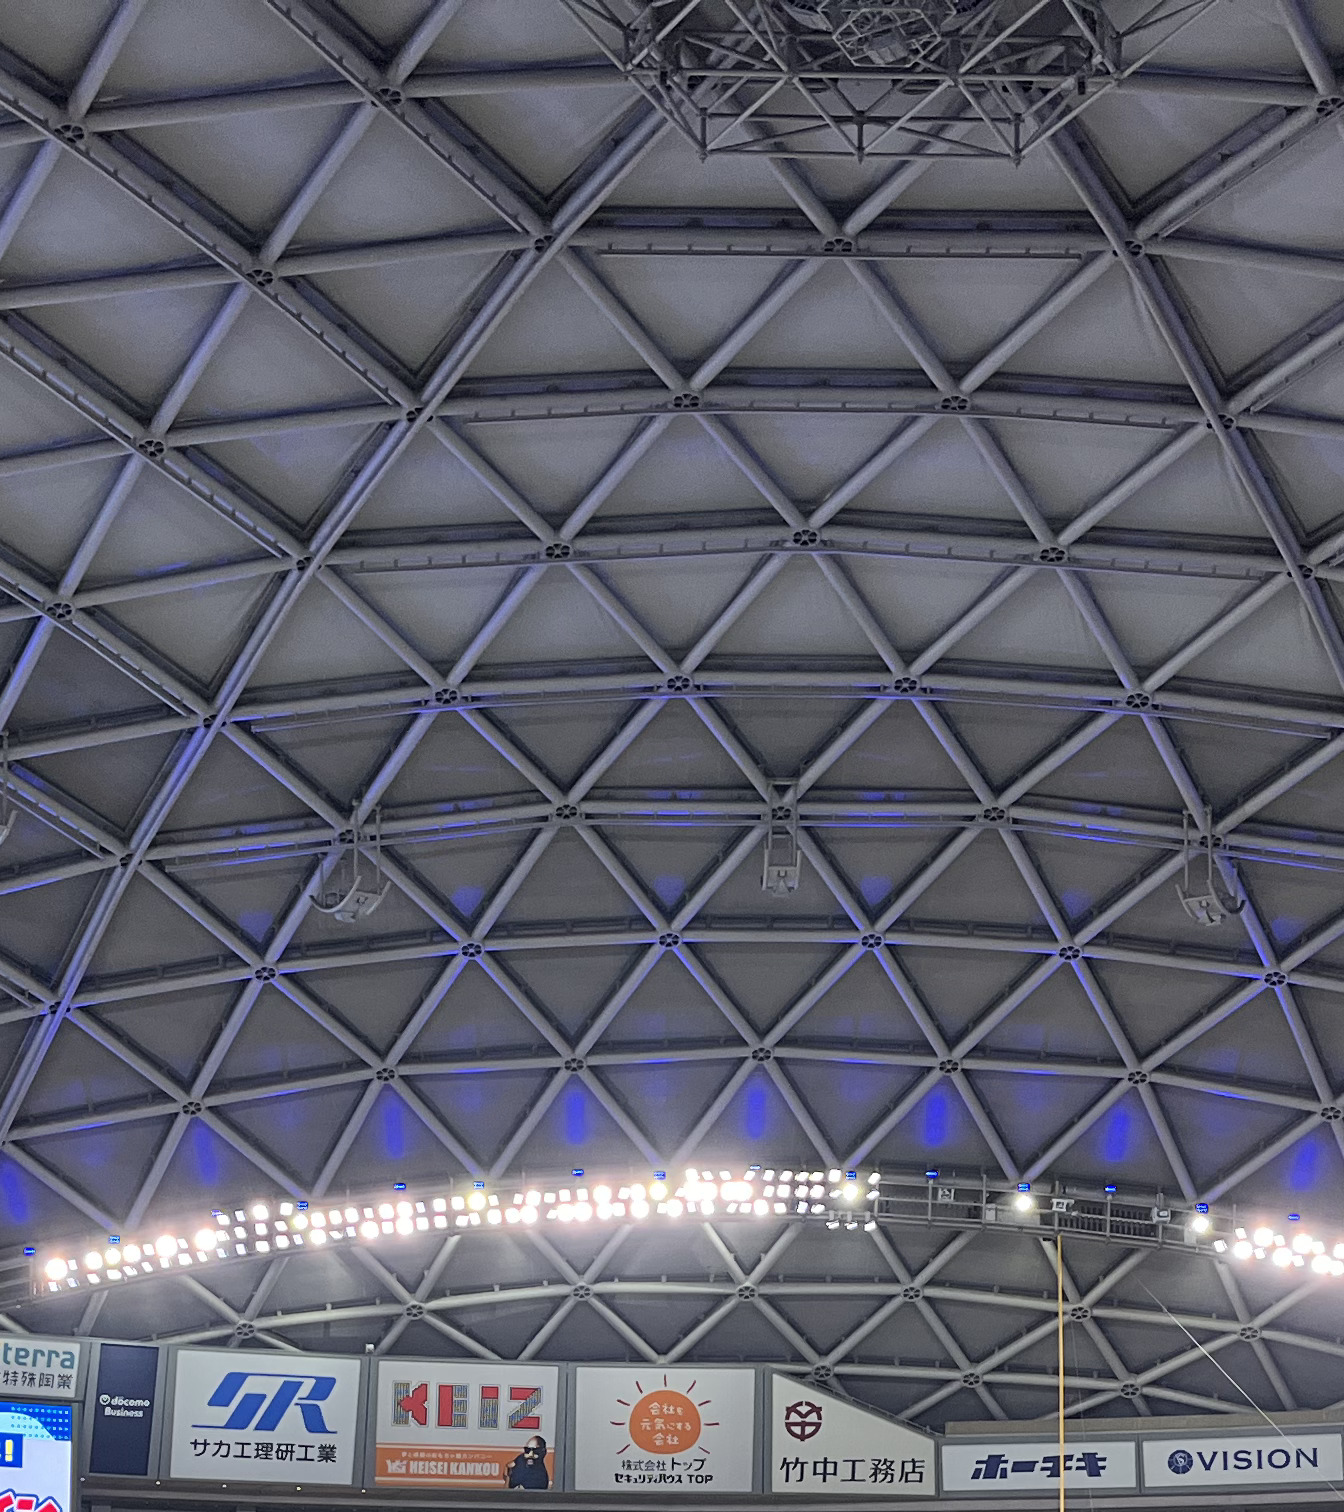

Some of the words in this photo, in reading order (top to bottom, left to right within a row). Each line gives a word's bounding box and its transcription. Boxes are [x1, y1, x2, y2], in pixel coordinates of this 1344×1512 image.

[104, 1407, 144, 1418] Business
[391, 1380, 543, 1430] KEIZ
[652, 1433, 679, 1445] 会社
[621, 1460, 667, 1472] 株式会社
[671, 1458, 706, 1472] トップ
[971, 1452, 1107, 1479] ホーチキ
[1196, 1447, 1318, 1472] VISION
[410, 1462, 447, 1476] HEISEI
[450, 1462, 500, 1477] KANKOU
[780, 1457, 926, 1484] 竹中工務店
[688, 1474, 714, 1485] TOP
